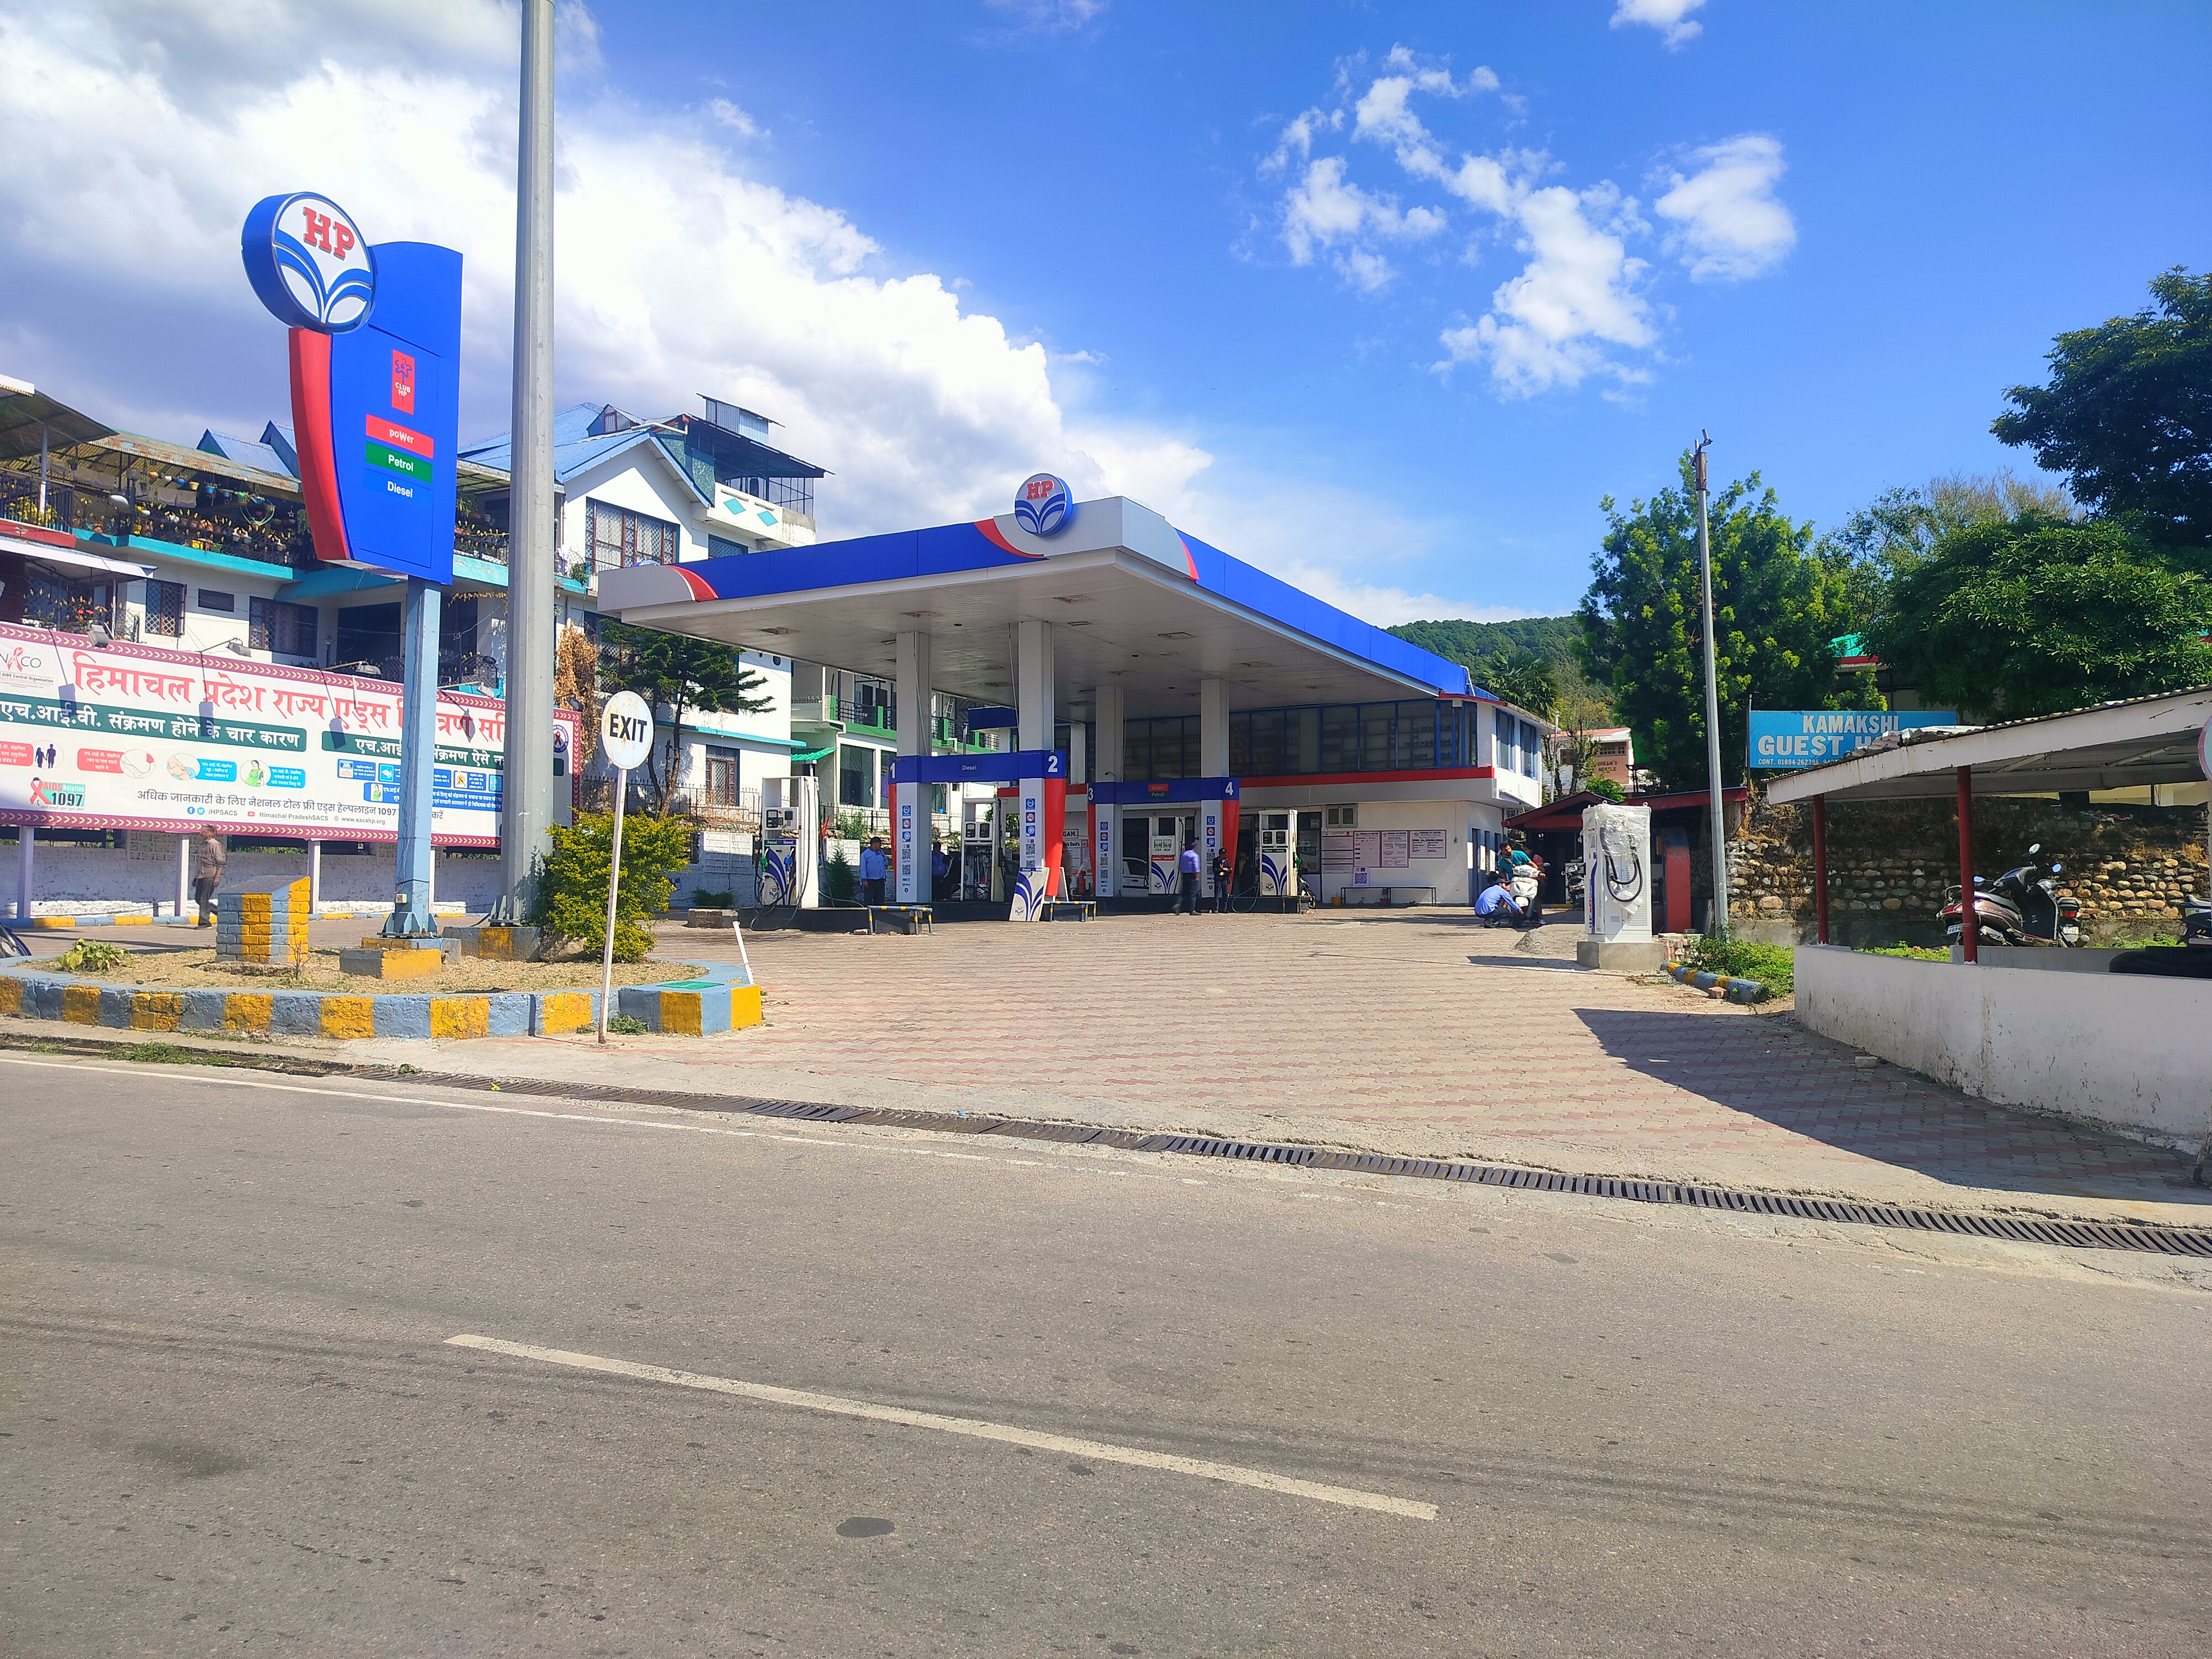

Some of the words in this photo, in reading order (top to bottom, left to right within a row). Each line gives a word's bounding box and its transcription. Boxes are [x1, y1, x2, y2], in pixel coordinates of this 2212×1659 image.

[302, 206, 354, 260] HP
[395, 382, 411, 393] CLUB
[398, 389, 408, 397] HP
[388, 454, 414, 472] Petrol
[387, 481, 413, 498] Diesel
[1027, 480, 1054, 499] HP
[72, 651, 195, 703] हिमाचल
[202, 672, 266, 712] प्रदेश
[273, 690, 328, 719] राज्य
[335, 697, 391, 734] एड्स
[0, 701, 101, 727] एच.आई.वी.
[108, 711, 166, 734] संक्रमण
[171, 717, 201, 738] होने
[206, 720, 221, 739] के
[225, 727, 256, 744] चार
[259, 730, 300, 748] कारण
[610, 713, 647, 743] EXIT
[1803, 714, 1899, 733] KAMAKSHI
[1758, 735, 1844, 756] GUEST
[472, 749, 490, 766] ऐसे
[1048, 755, 1058, 773] 2
[890, 763, 895, 779] 1
[43, 782, 62, 791] AIDS
[1088, 787, 1094, 801] 3
[1225, 781, 1234, 796] 4
[52, 792, 83, 806] 1097
[137, 789, 168, 801] अधिक
[170, 793, 213, 804] जानकारी
[215, 794, 226, 805] के
[227, 795, 247, 806] लिए
[248, 796, 281, 808] नेशनल
[283, 799, 301, 810] टोल
[302, 800, 315, 811] फ्री
[317, 802, 335, 814] एड्स
[337, 802, 376, 815] हेल्पलाइन
[378, 807, 396, 816] 1097
[432, 810, 444, 819] करें
